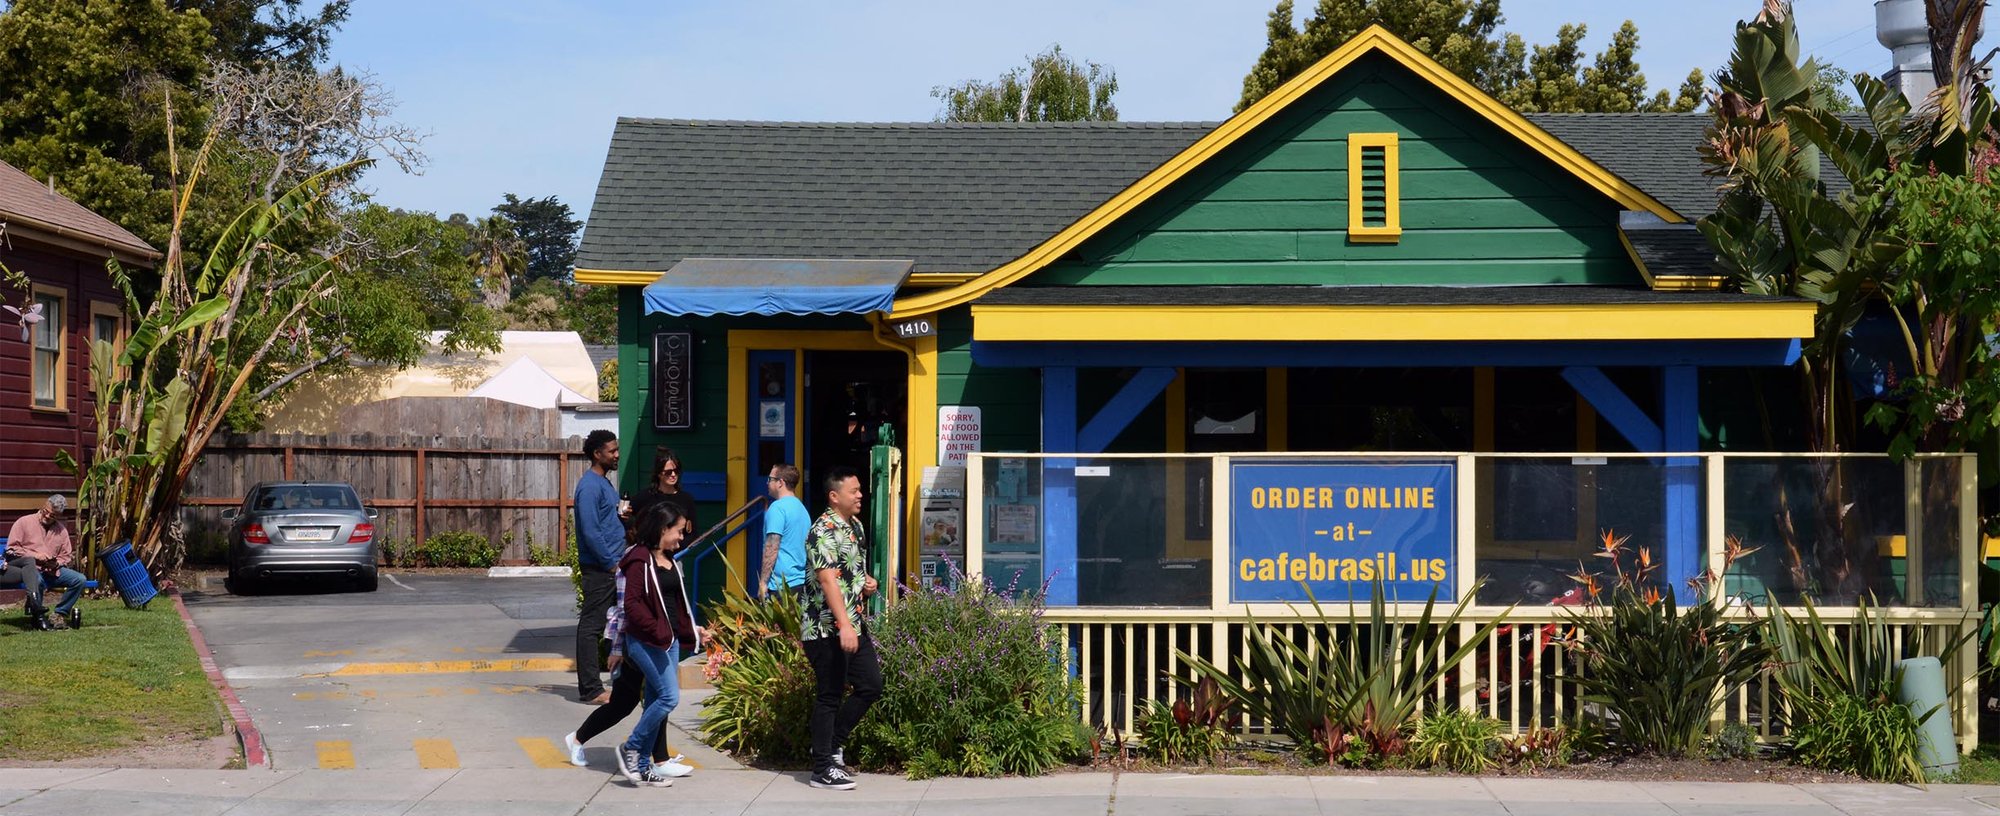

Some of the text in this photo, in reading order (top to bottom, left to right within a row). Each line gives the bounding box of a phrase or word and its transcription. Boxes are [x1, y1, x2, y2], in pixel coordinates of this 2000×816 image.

[899, 321, 929, 336] 1410
[666, 335, 681, 425] CLOSED
[946, 414, 974, 422] SORRY,
[946, 443, 975, 451] ON THE
[1251, 487, 1435, 509] ORDER ONLINE
[1240, 552, 1447, 581] cafebrasil.us
